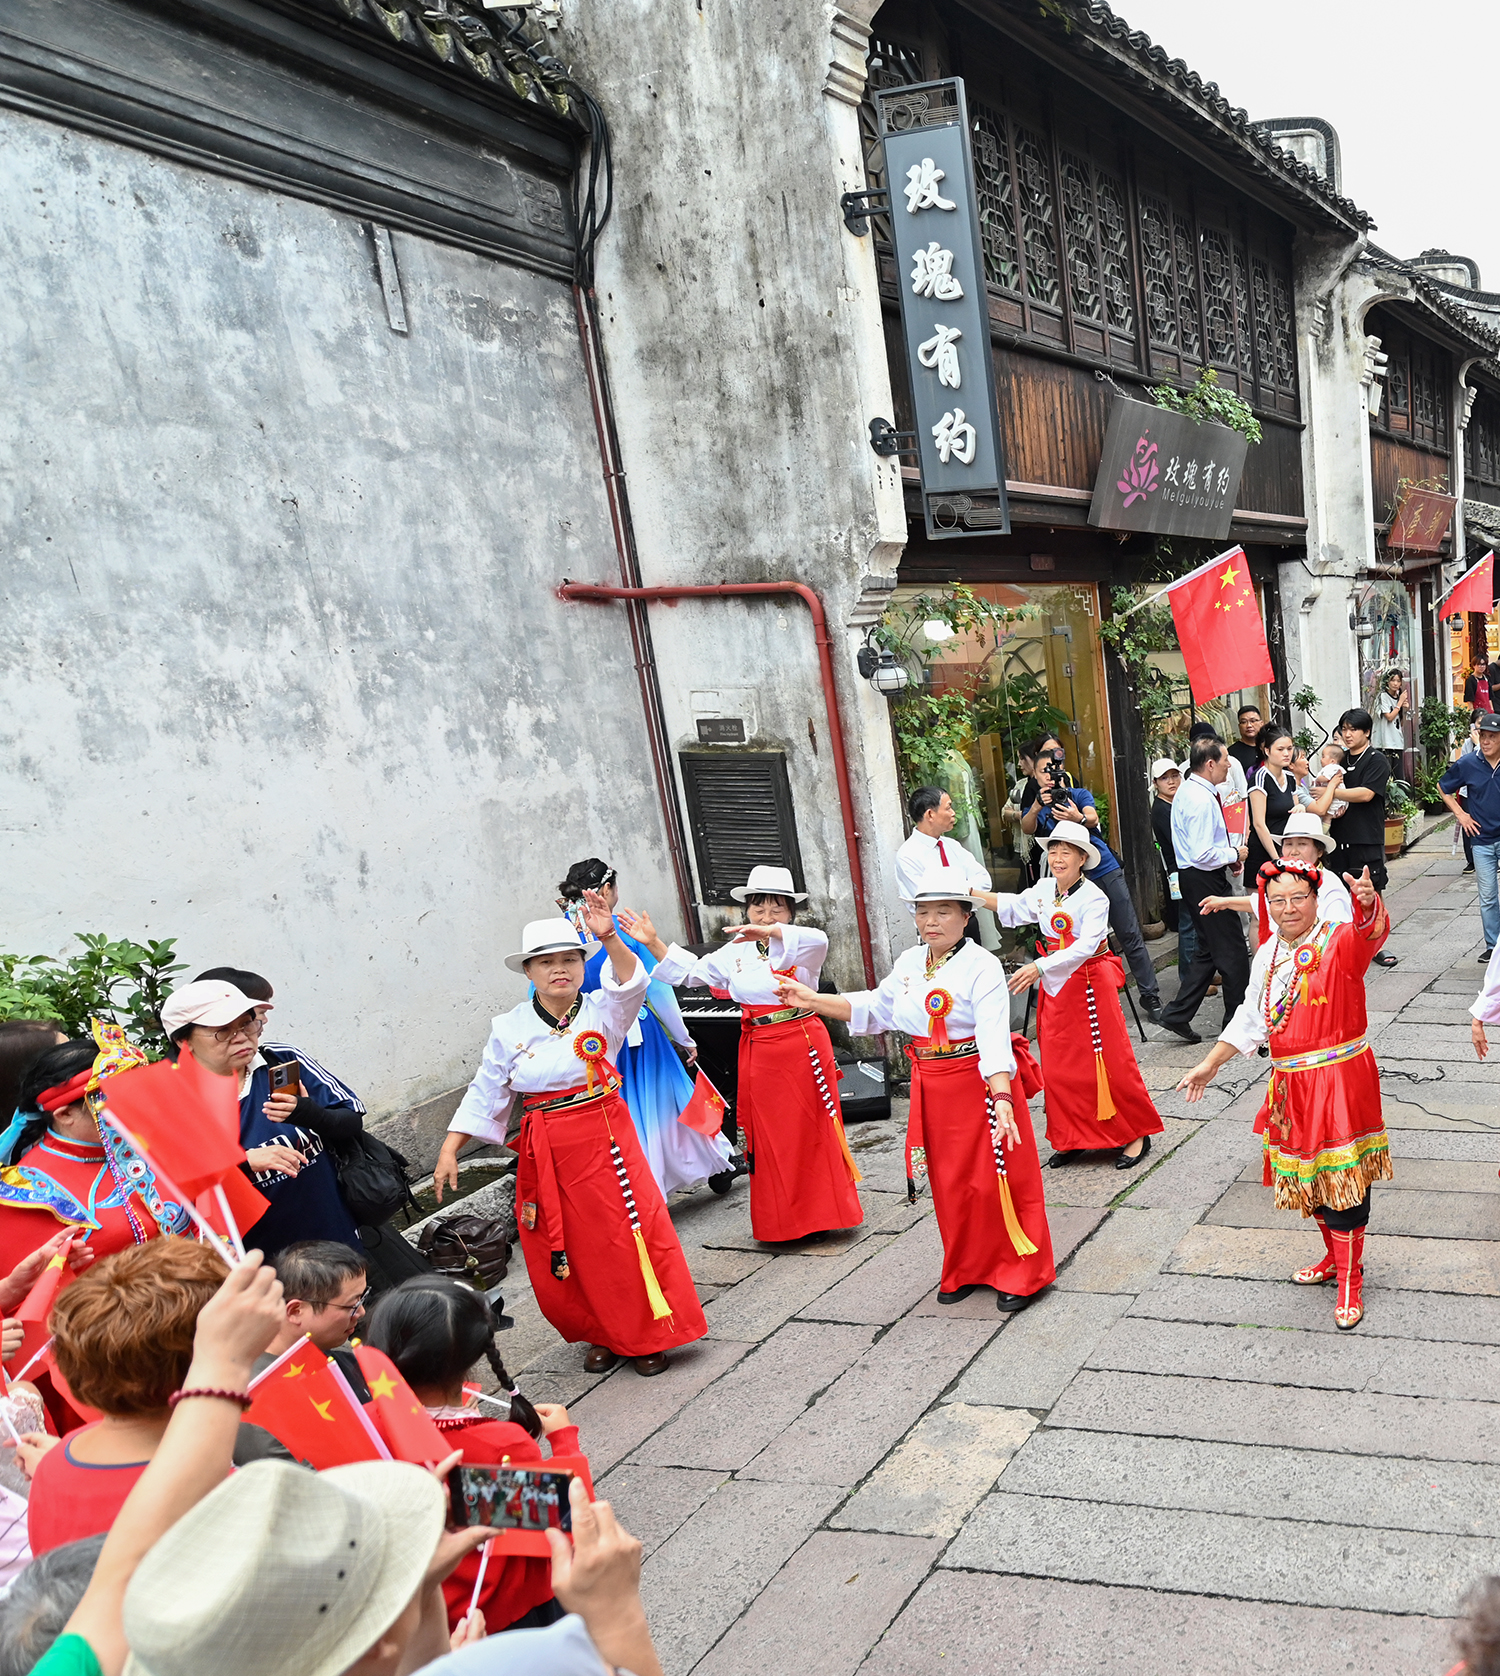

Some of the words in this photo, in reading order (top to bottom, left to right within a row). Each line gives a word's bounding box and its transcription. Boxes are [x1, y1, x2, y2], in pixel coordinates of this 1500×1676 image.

[903, 157, 977, 466] 玫瑰有约
[1164, 455, 1230, 496] 玫瑰有约
